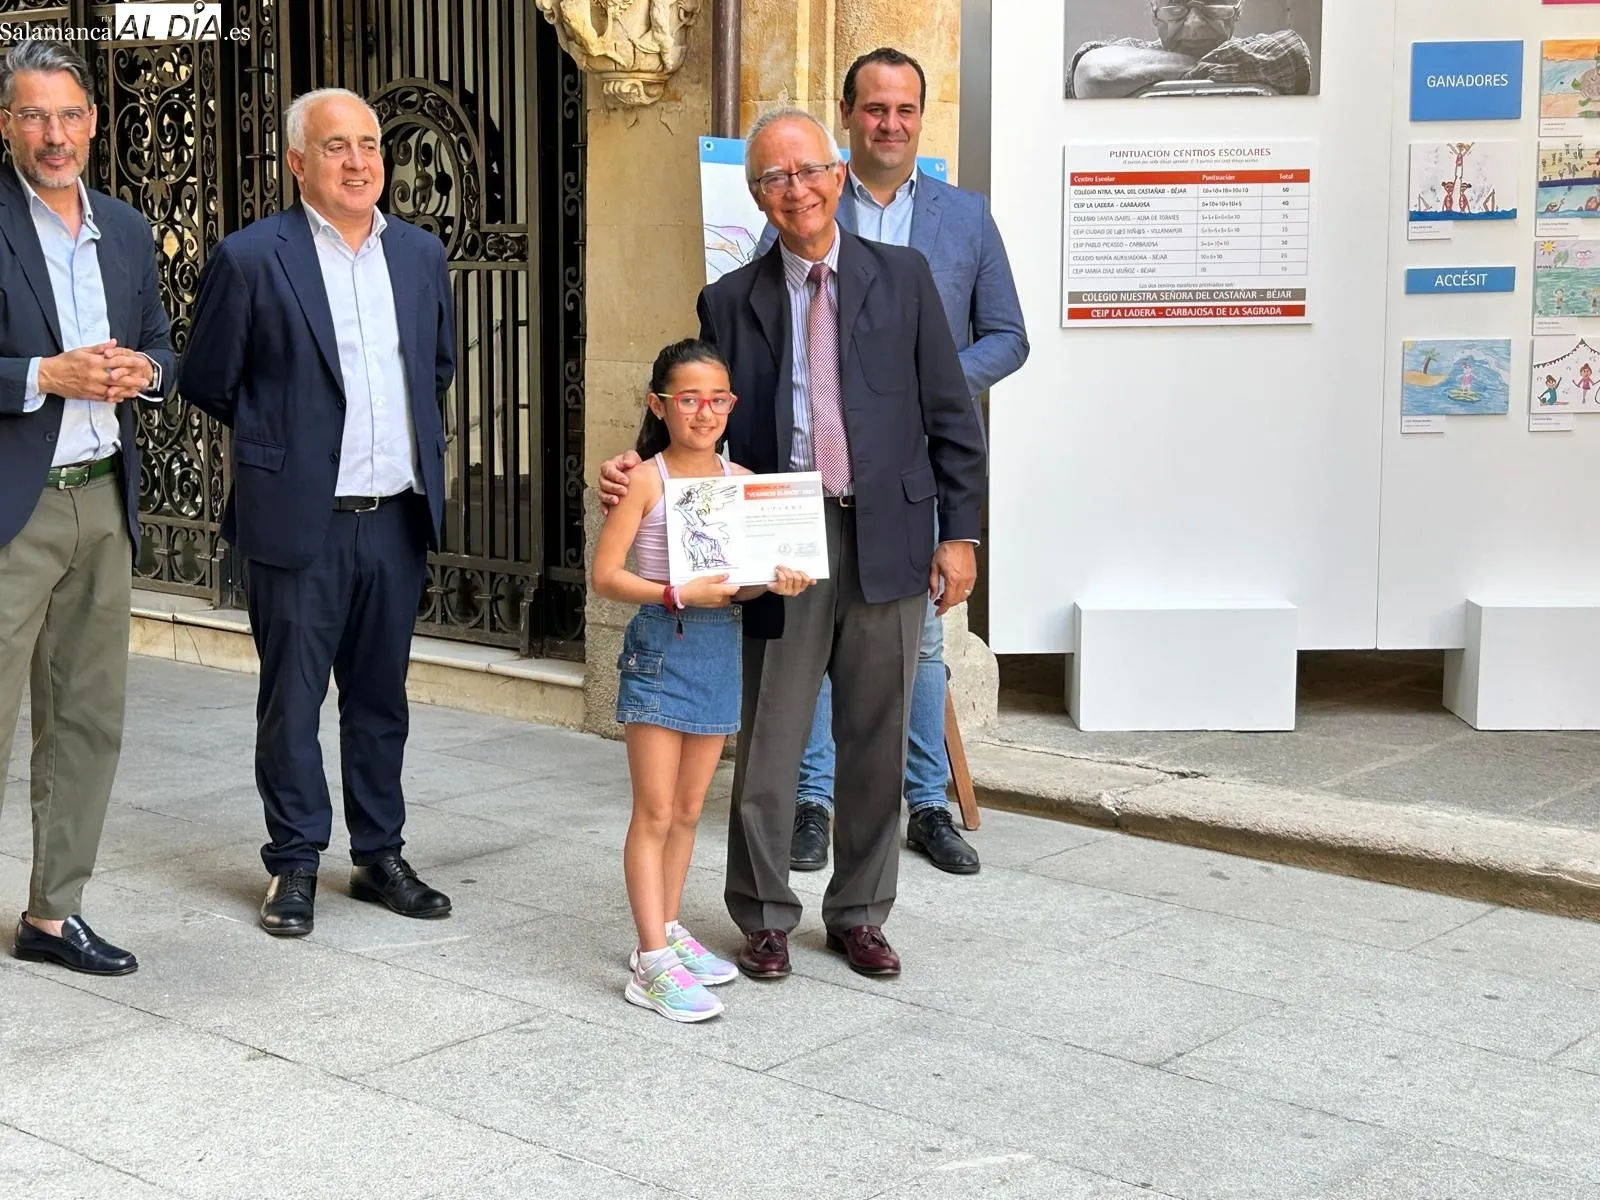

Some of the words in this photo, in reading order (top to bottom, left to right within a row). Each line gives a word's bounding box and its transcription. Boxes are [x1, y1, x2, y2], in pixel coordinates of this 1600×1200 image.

[1427, 74, 1509, 88] GANADORES
[1173, 149, 1216, 157] CENTROS
[1219, 148, 1271, 156] ESCOLARES
[1434, 270, 1488, 287] ACCÉSIT
[1082, 293, 1118, 302] COLEGIO
[1120, 292, 1158, 301] NUESTRA
[1160, 290, 1194, 300] SEÑORA
[1195, 291, 1211, 300] DEL
[1213, 288, 1257, 299] CASTAÑAR
[1266, 288, 1292, 298] BÉJAR
[1091, 309, 1110, 318] CEIP
[1111, 309, 1122, 317] LA
[1124, 308, 1156, 317] LADERA
[1165, 308, 1214, 316] CARBAJOSA
[1241, 307, 1282, 315] SAGRADA
